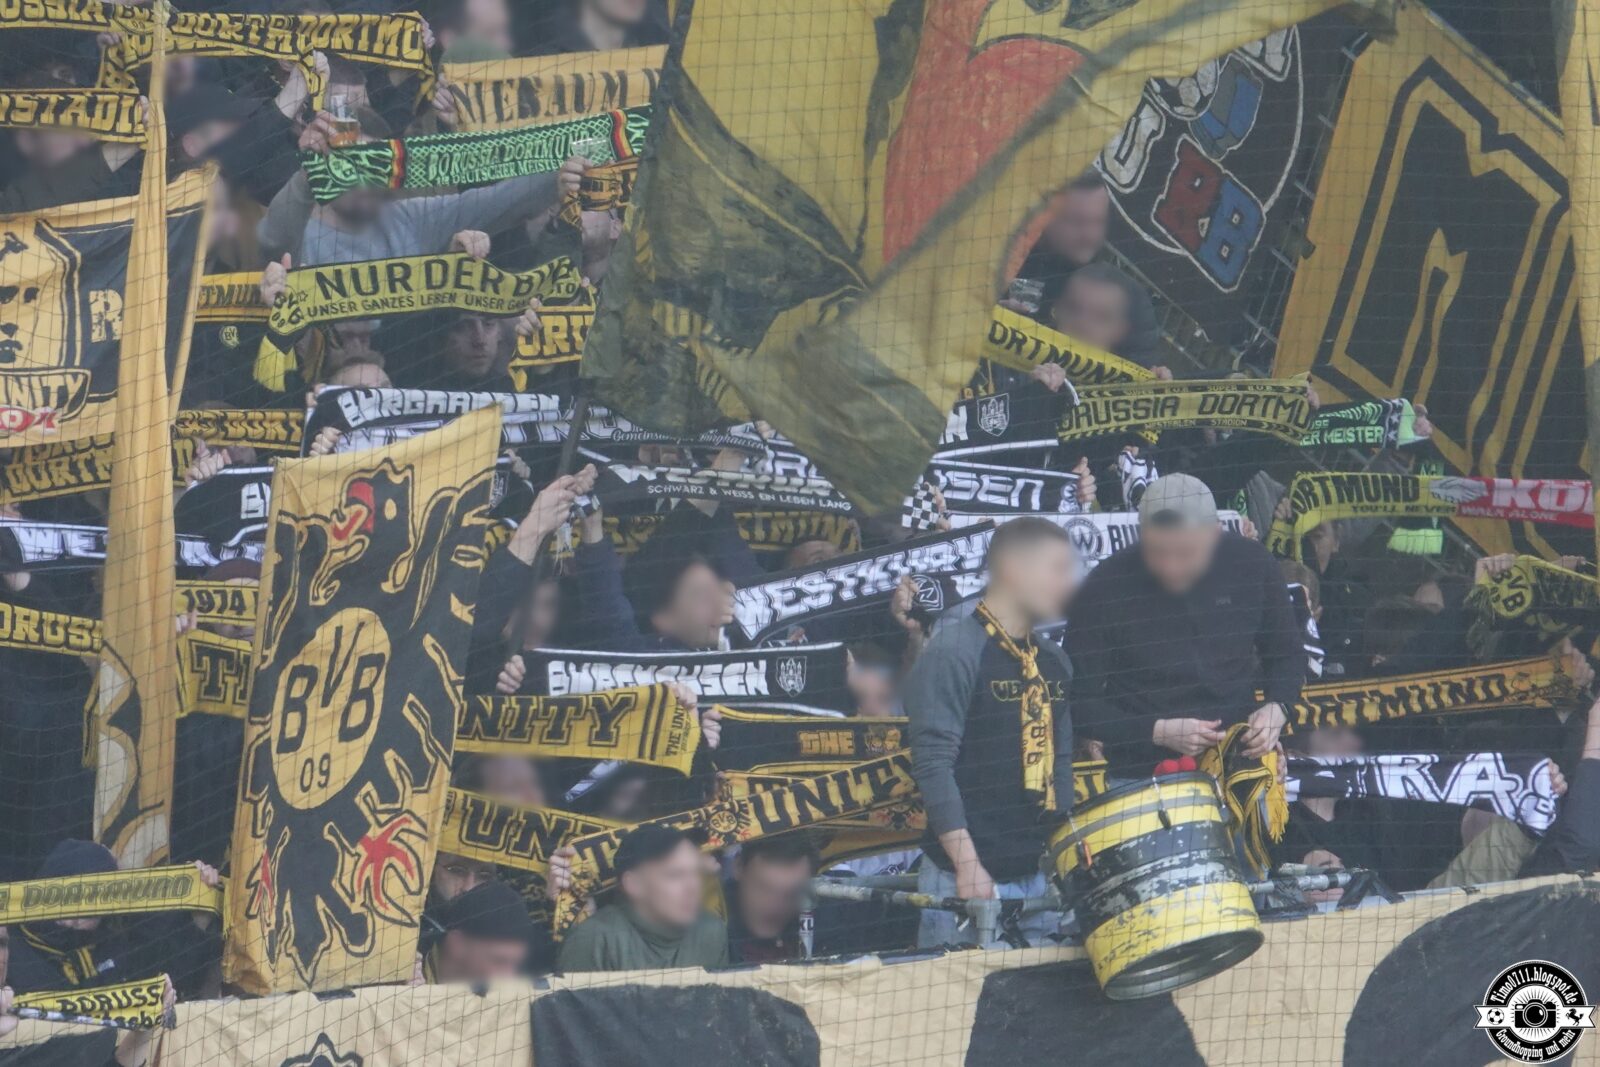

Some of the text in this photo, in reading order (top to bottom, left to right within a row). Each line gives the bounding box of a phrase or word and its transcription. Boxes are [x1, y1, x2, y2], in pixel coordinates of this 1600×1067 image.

[427, 147, 501, 181] BORUSSIA
[314, 261, 414, 300] NUR
[424, 256, 504, 296] DER
[307, 301, 358, 318] UNSER
[361, 296, 415, 312] GANZES
[420, 292, 457, 306] LEBEN
[464, 295, 505, 311] UNSER
[1324, 425, 1384, 444] MEISTER
[648, 485, 704, 494] SCHWARZ
[709, 487, 717, 496] &
[722, 489, 755, 499] WEISS
[759, 492, 776, 500] EIN
[819, 499, 851, 510] LANG
[182, 589, 247, 615] 1974
[735, 531, 994, 641] WESTKURV
[276, 621, 386, 753] BVB
[300, 753, 331, 793] 09
[22, 874, 193, 908] DORTMUND
